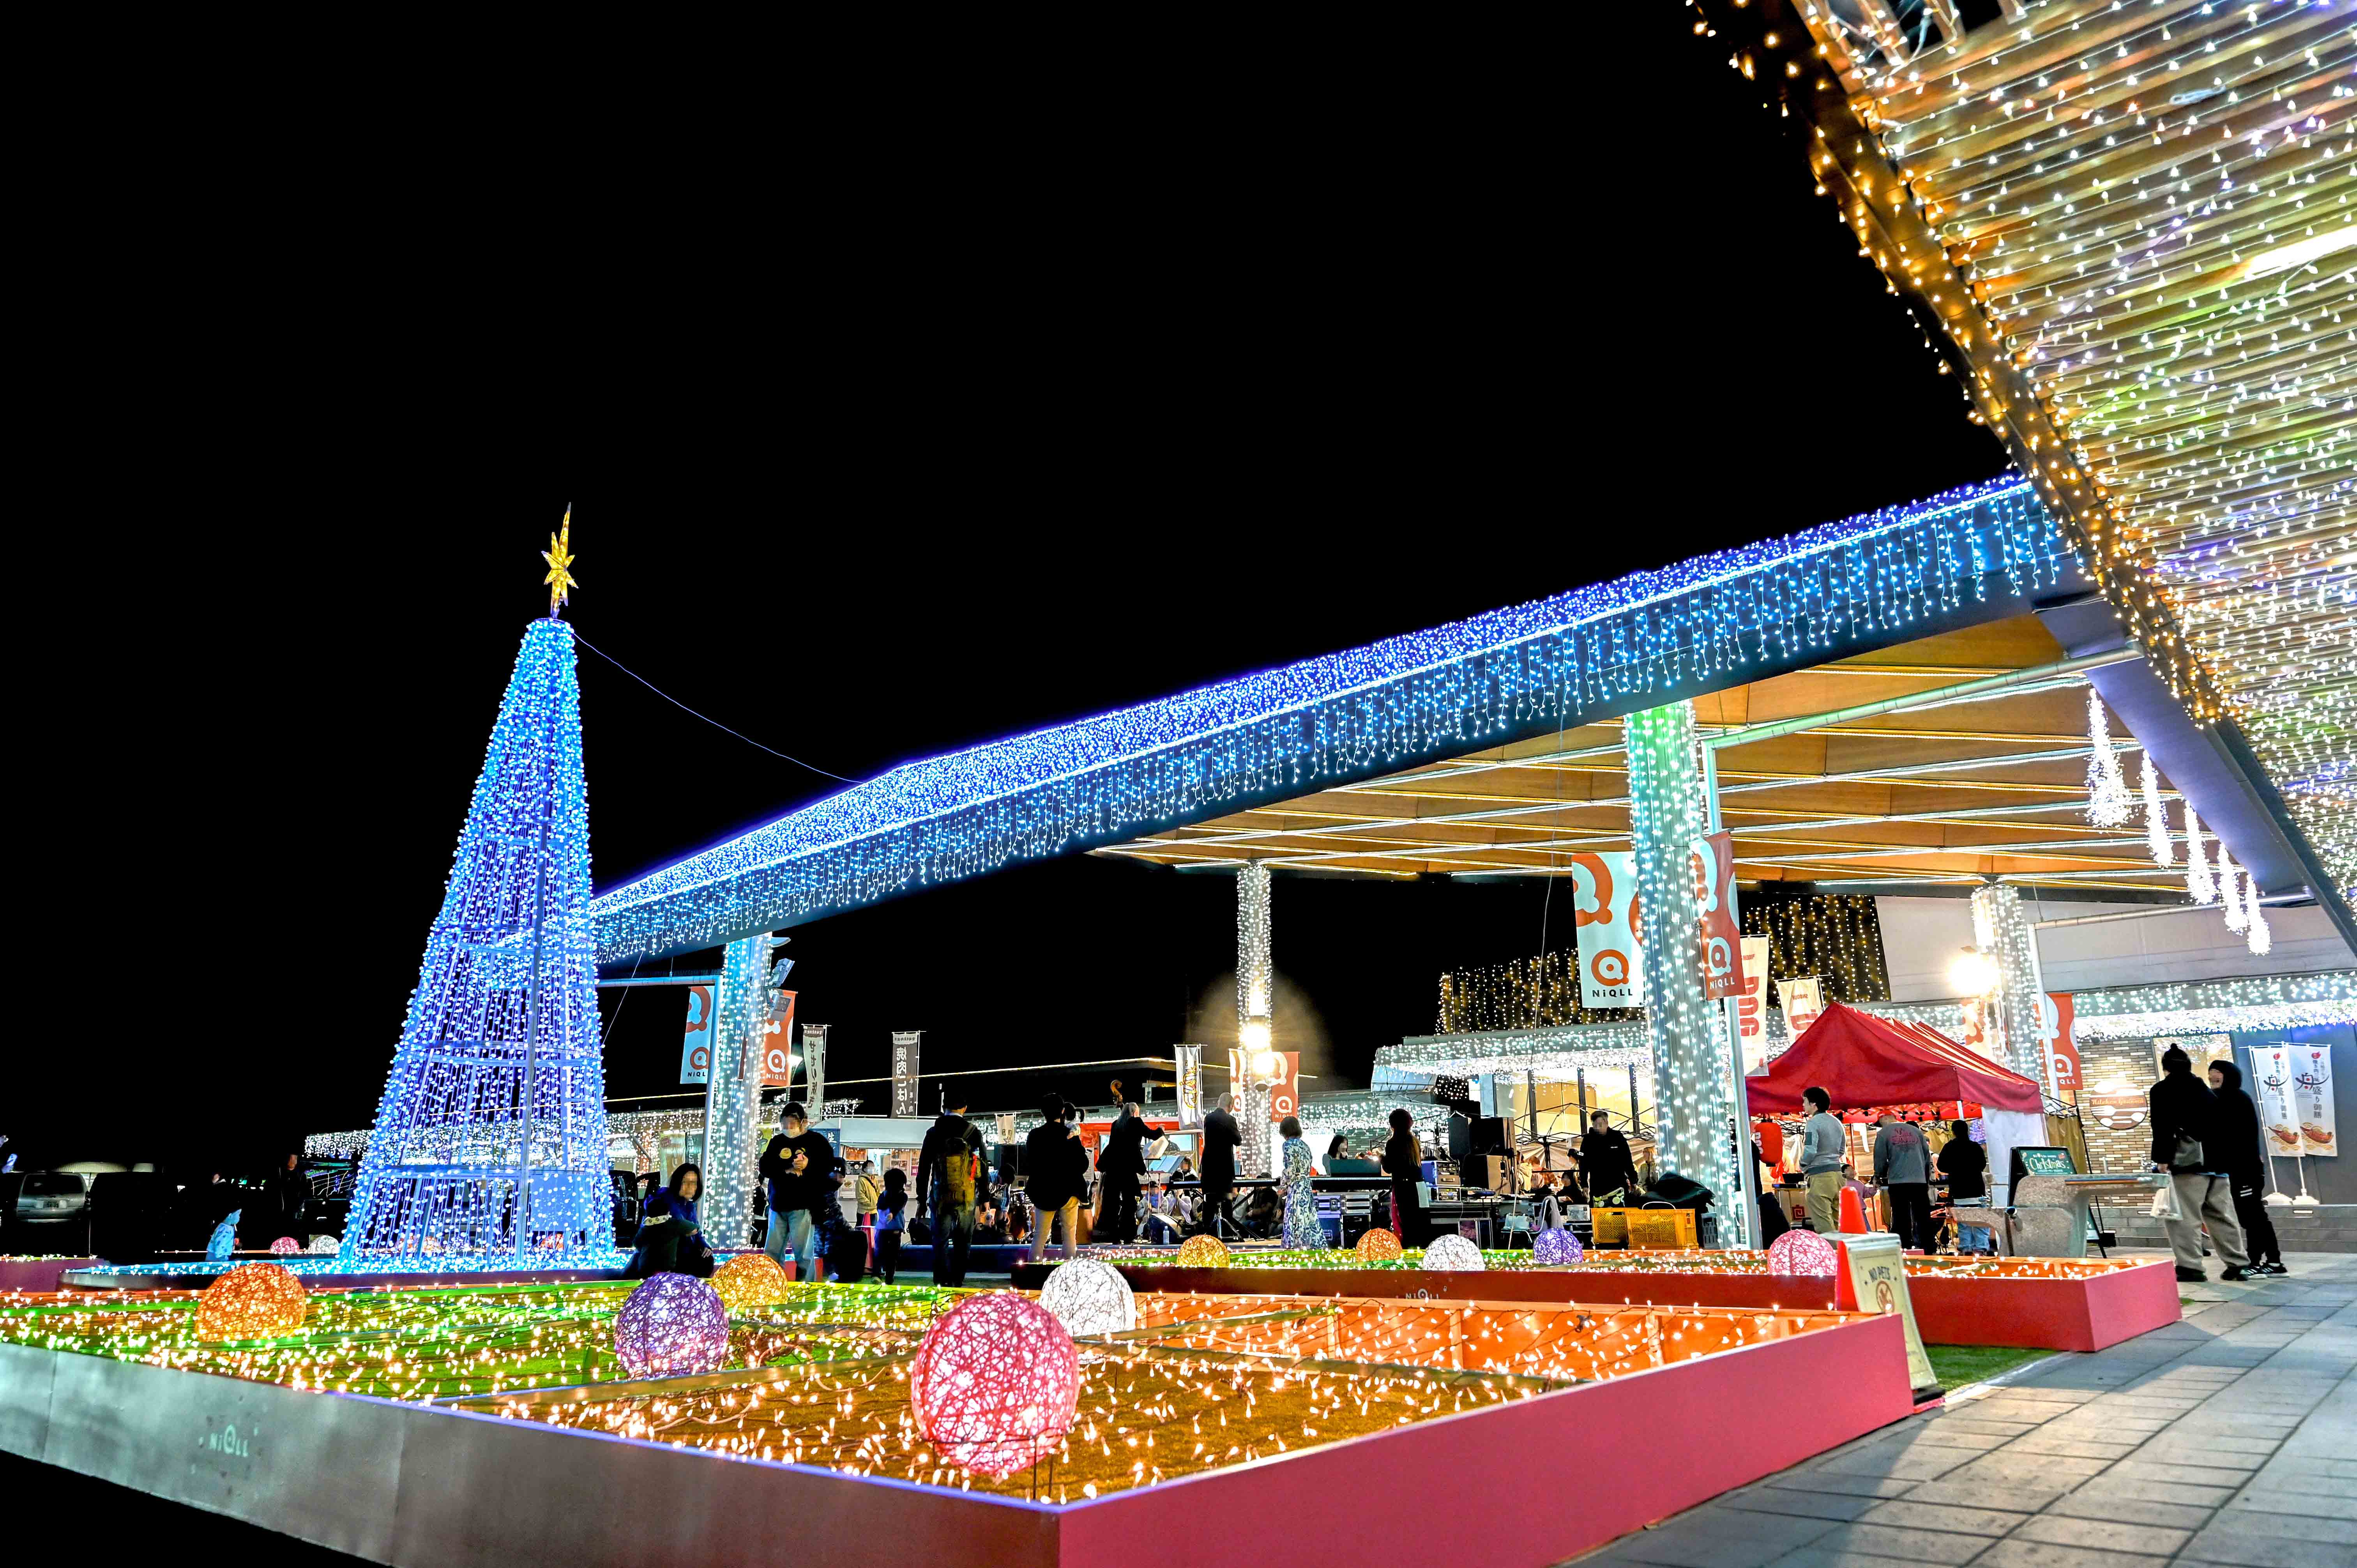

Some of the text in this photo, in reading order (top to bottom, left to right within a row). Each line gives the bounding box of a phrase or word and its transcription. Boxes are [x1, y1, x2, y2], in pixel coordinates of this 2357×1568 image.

[1710, 976, 1735, 989] NiQLL
[1592, 988, 1633, 998] NiQLL
[2029, 1158, 2066, 1170] Christmas
[1877, 1266, 1890, 1280] PETS
